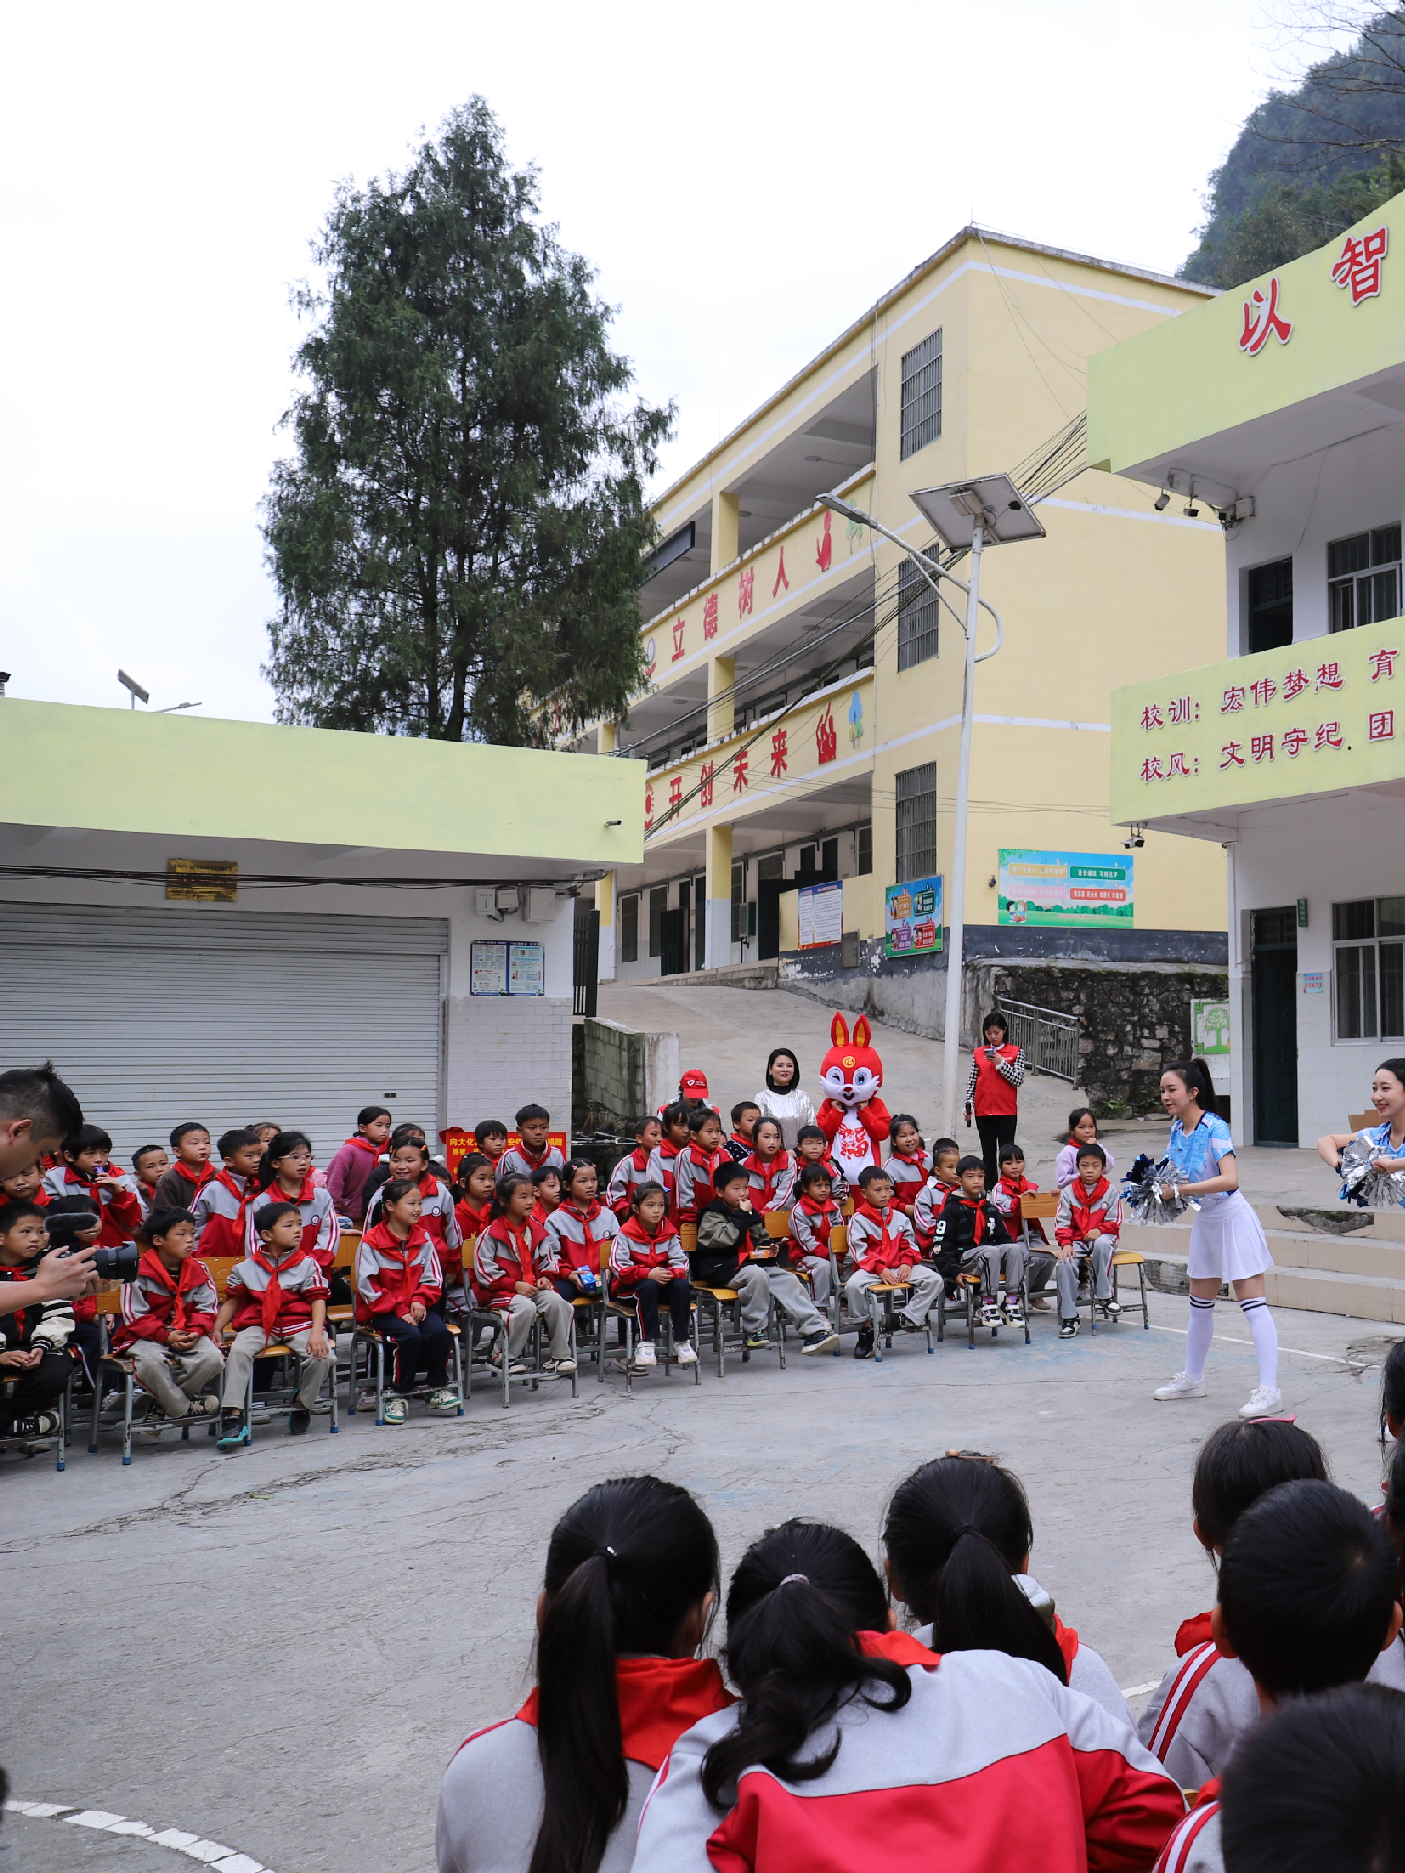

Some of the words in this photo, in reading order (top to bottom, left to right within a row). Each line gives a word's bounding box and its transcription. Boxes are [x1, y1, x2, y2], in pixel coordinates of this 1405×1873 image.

[1219, 662, 1346, 713] 宏伟梦想
[1219, 721, 1346, 770] 文明守纪
